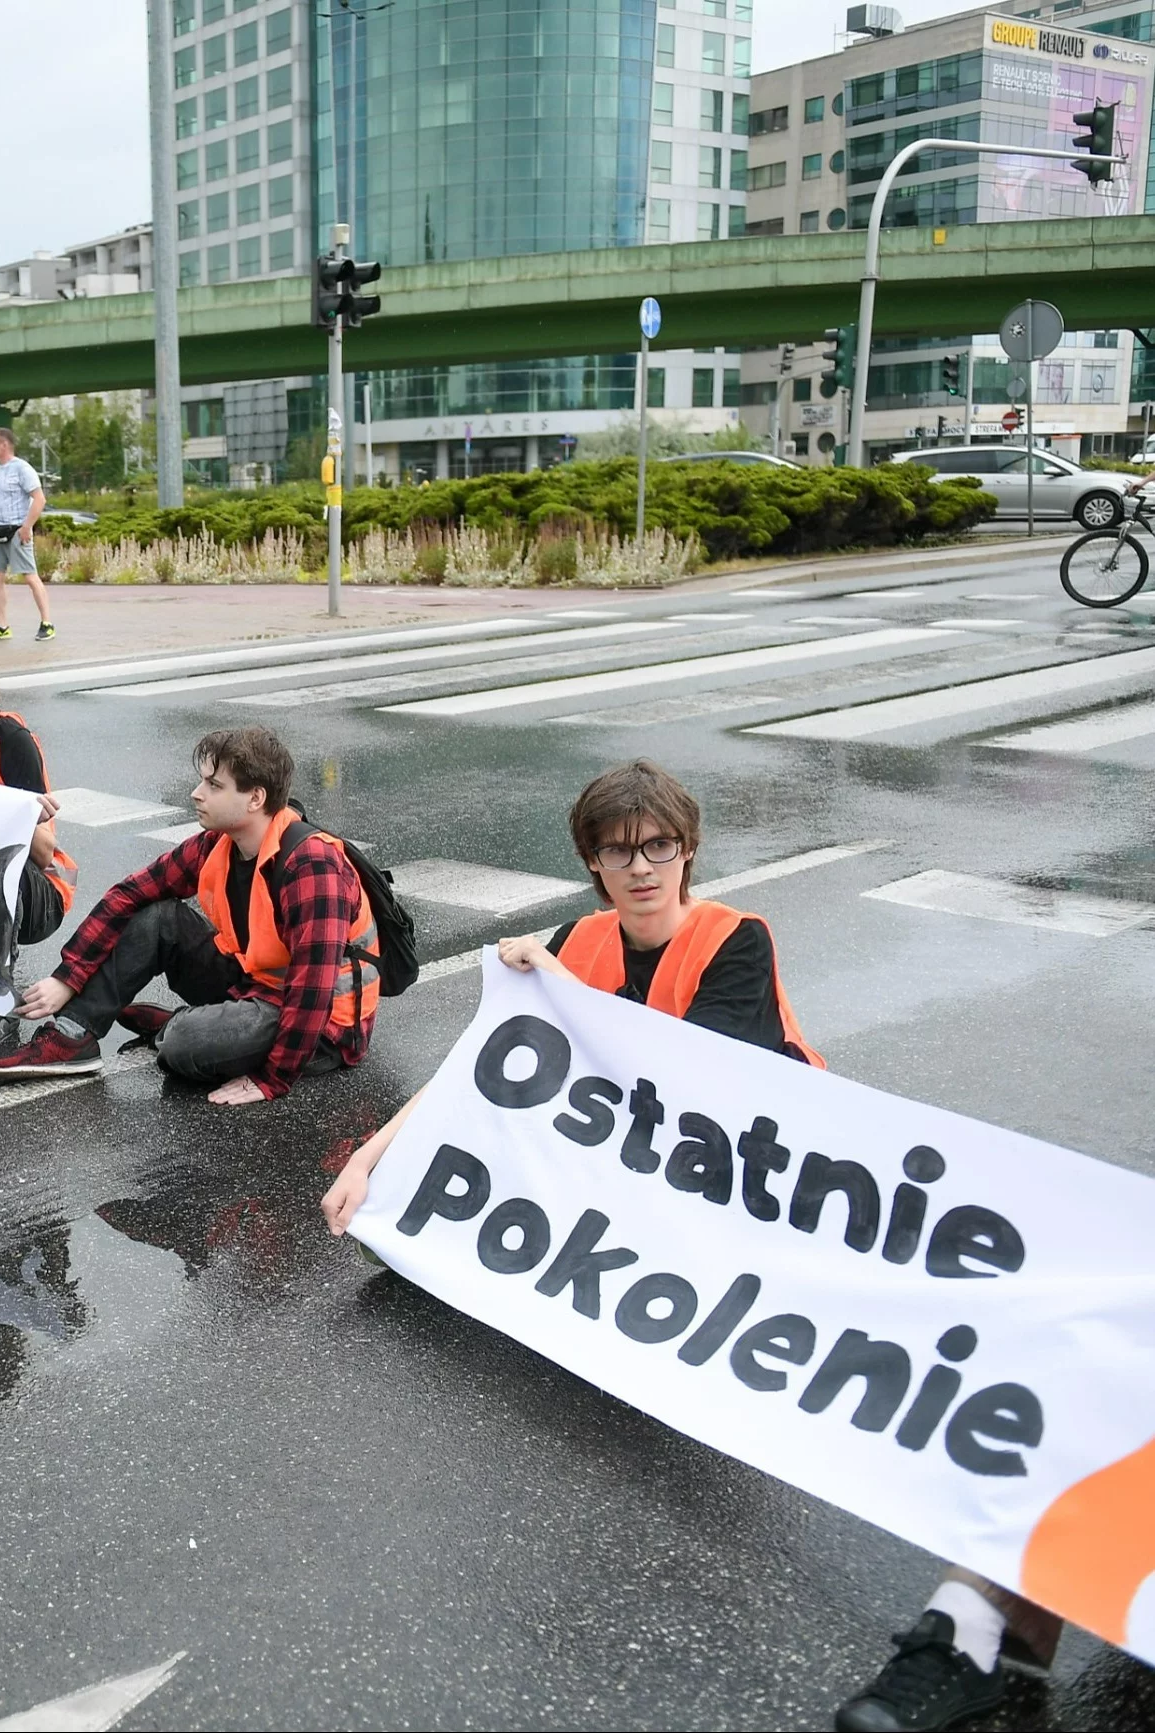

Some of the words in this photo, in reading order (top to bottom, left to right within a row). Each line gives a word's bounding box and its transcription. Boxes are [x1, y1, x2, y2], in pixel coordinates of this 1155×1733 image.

[992, 21, 1038, 50] GROUPE
[1039, 30, 1086, 58] RENAULT
[992, 76, 1023, 93] E-TECH
[993, 63, 1031, 80] RENAULT
[474, 1014, 1026, 1278] Ostatnie
[396, 1144, 1044, 1477] Pokolenie
